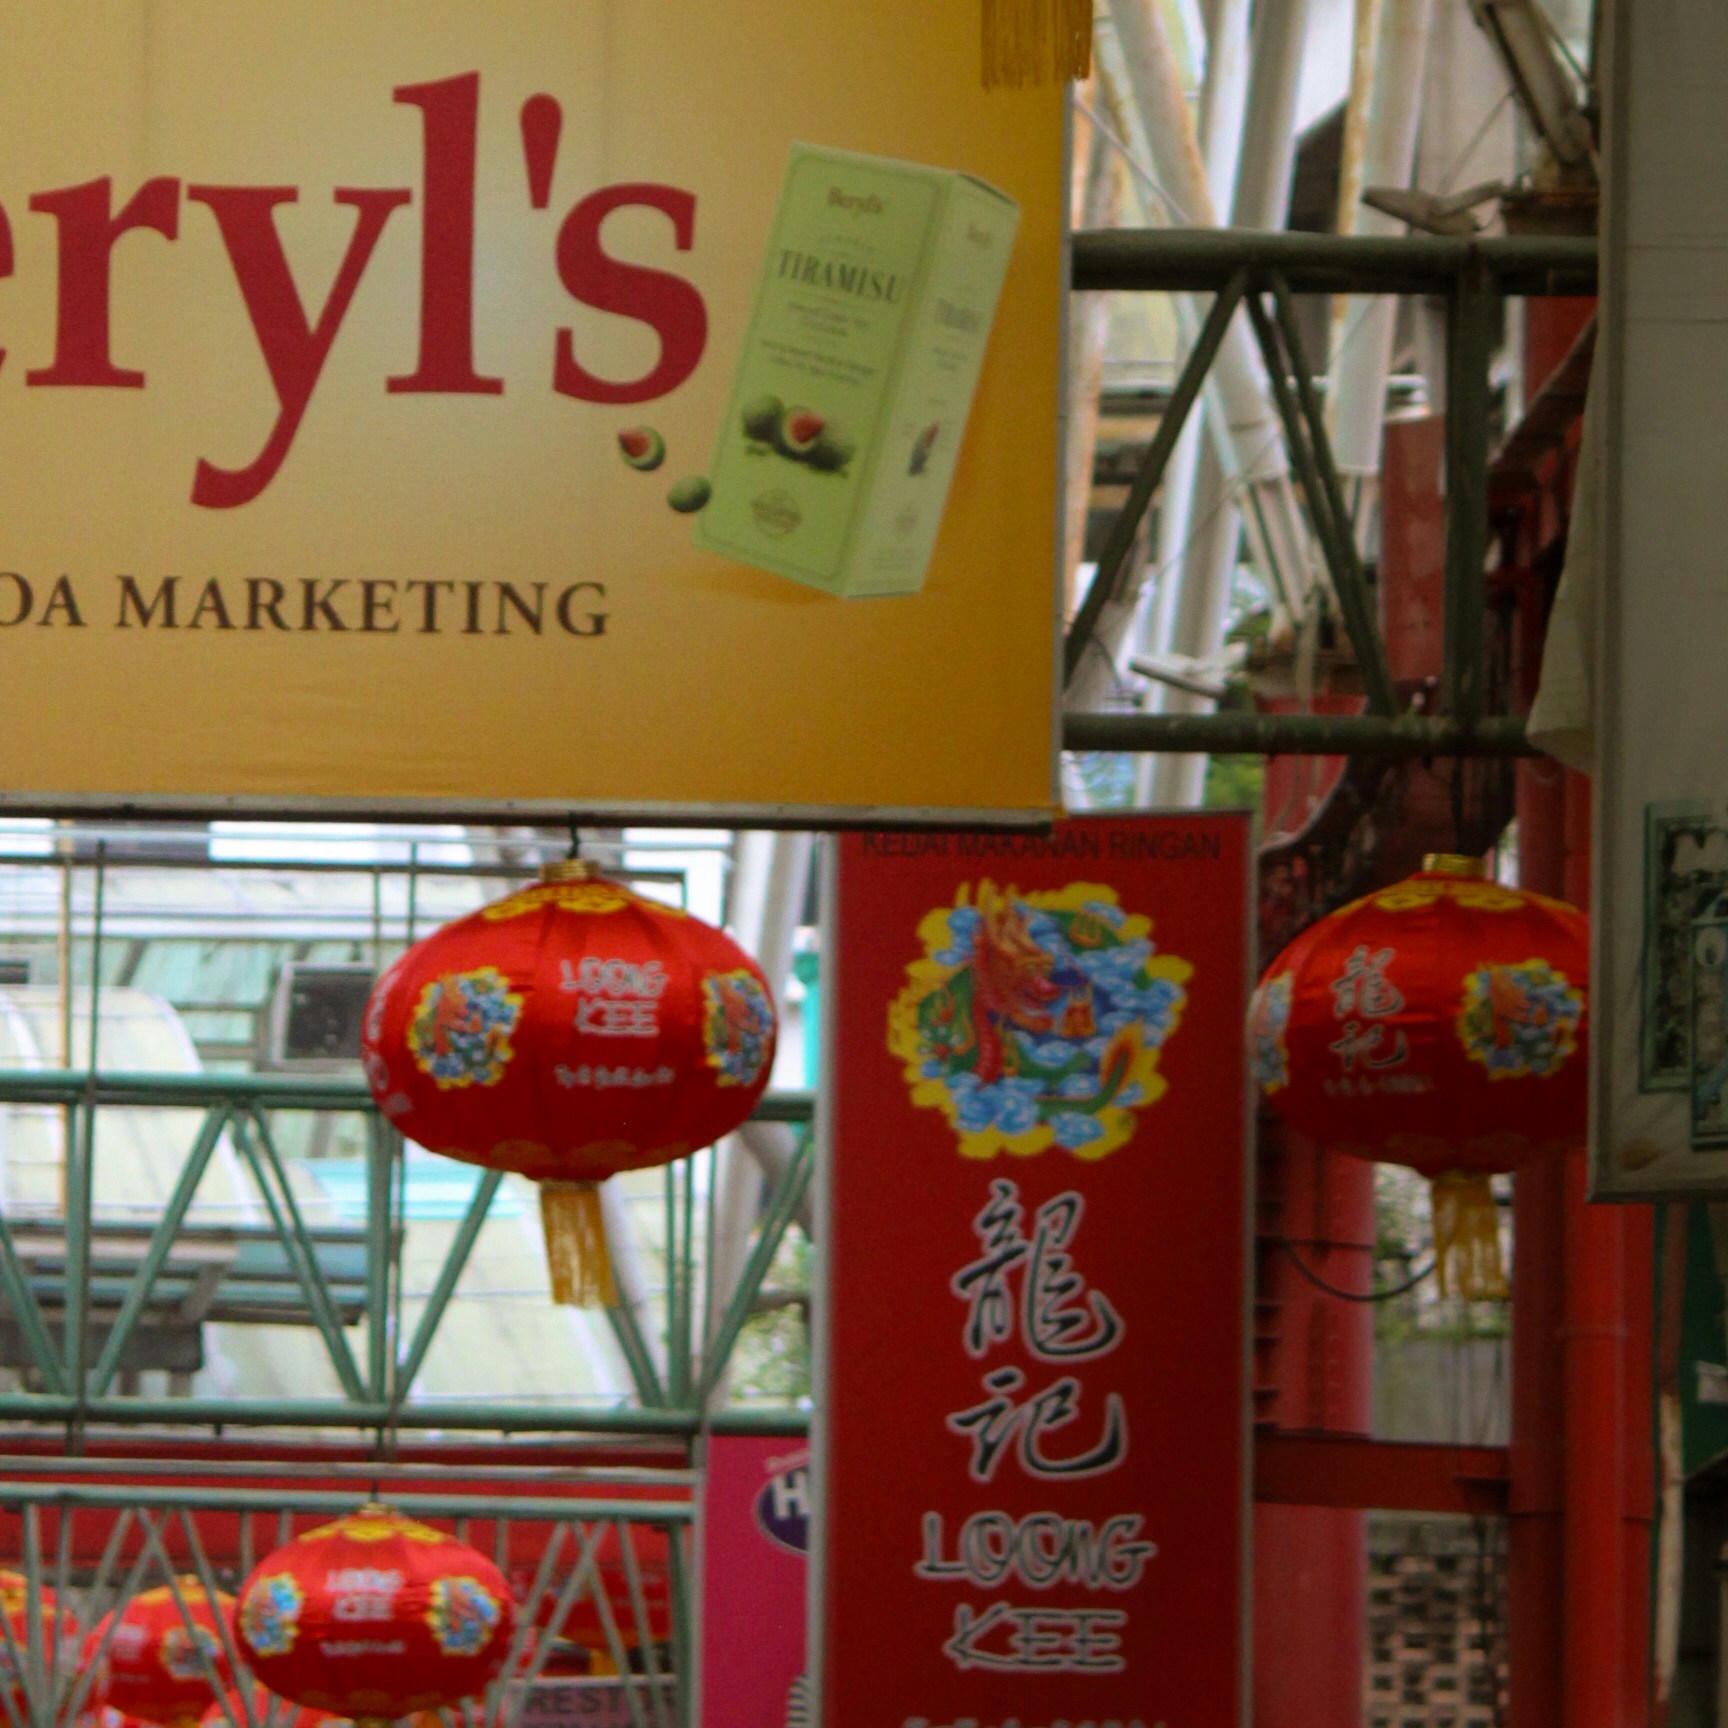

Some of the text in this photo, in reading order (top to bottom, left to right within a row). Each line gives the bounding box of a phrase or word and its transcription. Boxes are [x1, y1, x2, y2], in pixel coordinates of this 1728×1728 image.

[114, 573, 611, 638] MARKETING
[1110, 830, 1221, 861] RINGAN
[559, 957, 669, 998] LOONG
[574, 997, 660, 1039] KEE
[947, 1176, 1127, 1480] 龍記
[912, 1509, 1161, 1594] LOONG
[940, 1599, 1130, 1676] KEE
